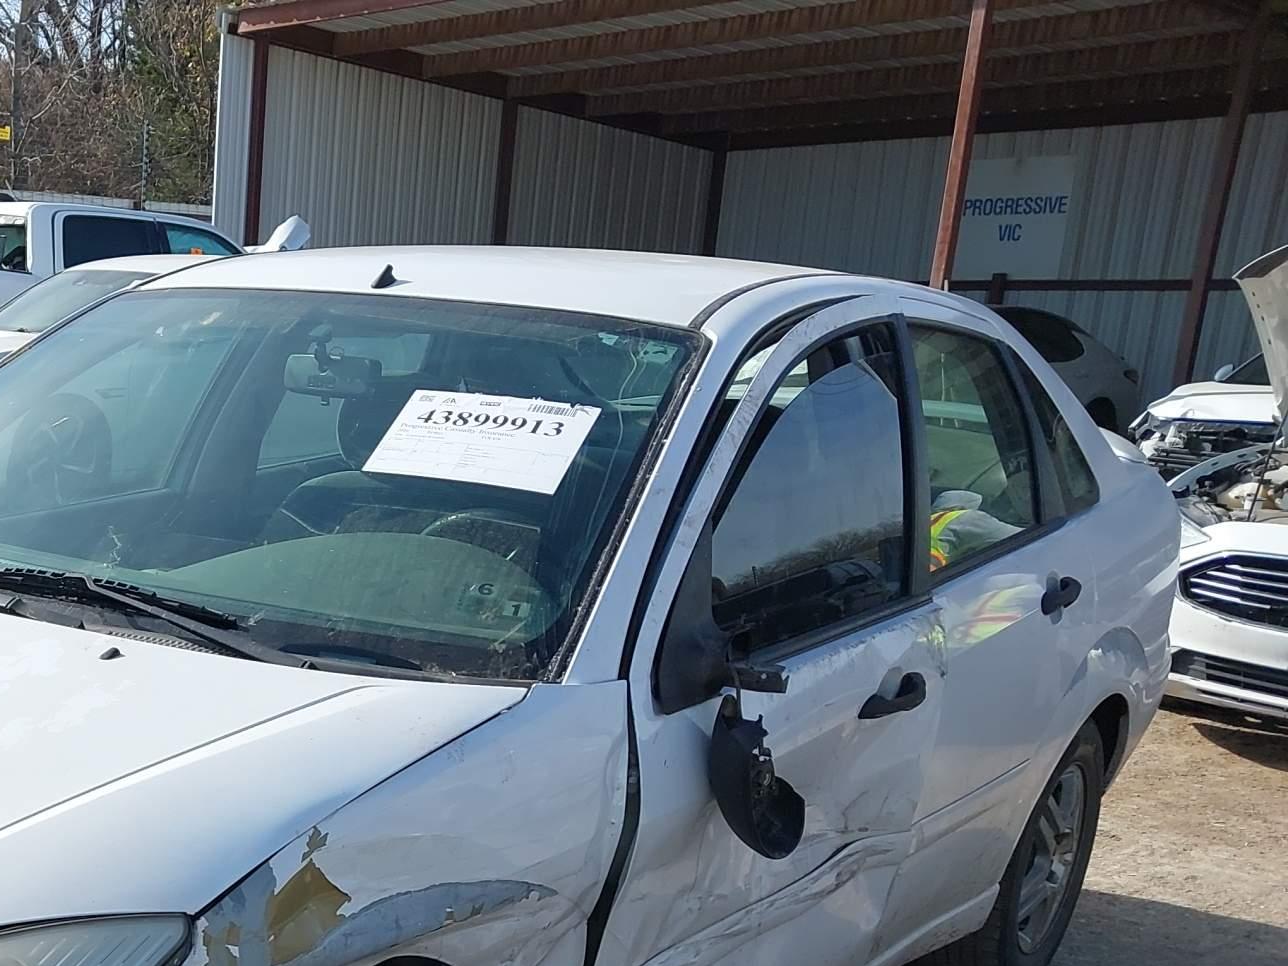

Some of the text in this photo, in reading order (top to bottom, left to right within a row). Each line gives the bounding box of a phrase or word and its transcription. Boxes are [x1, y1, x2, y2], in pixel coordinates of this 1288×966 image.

[963, 196, 1069, 216] PROGRESSIVE
[998, 224, 1023, 242] VIC
[416, 408, 564, 438] 43899913
